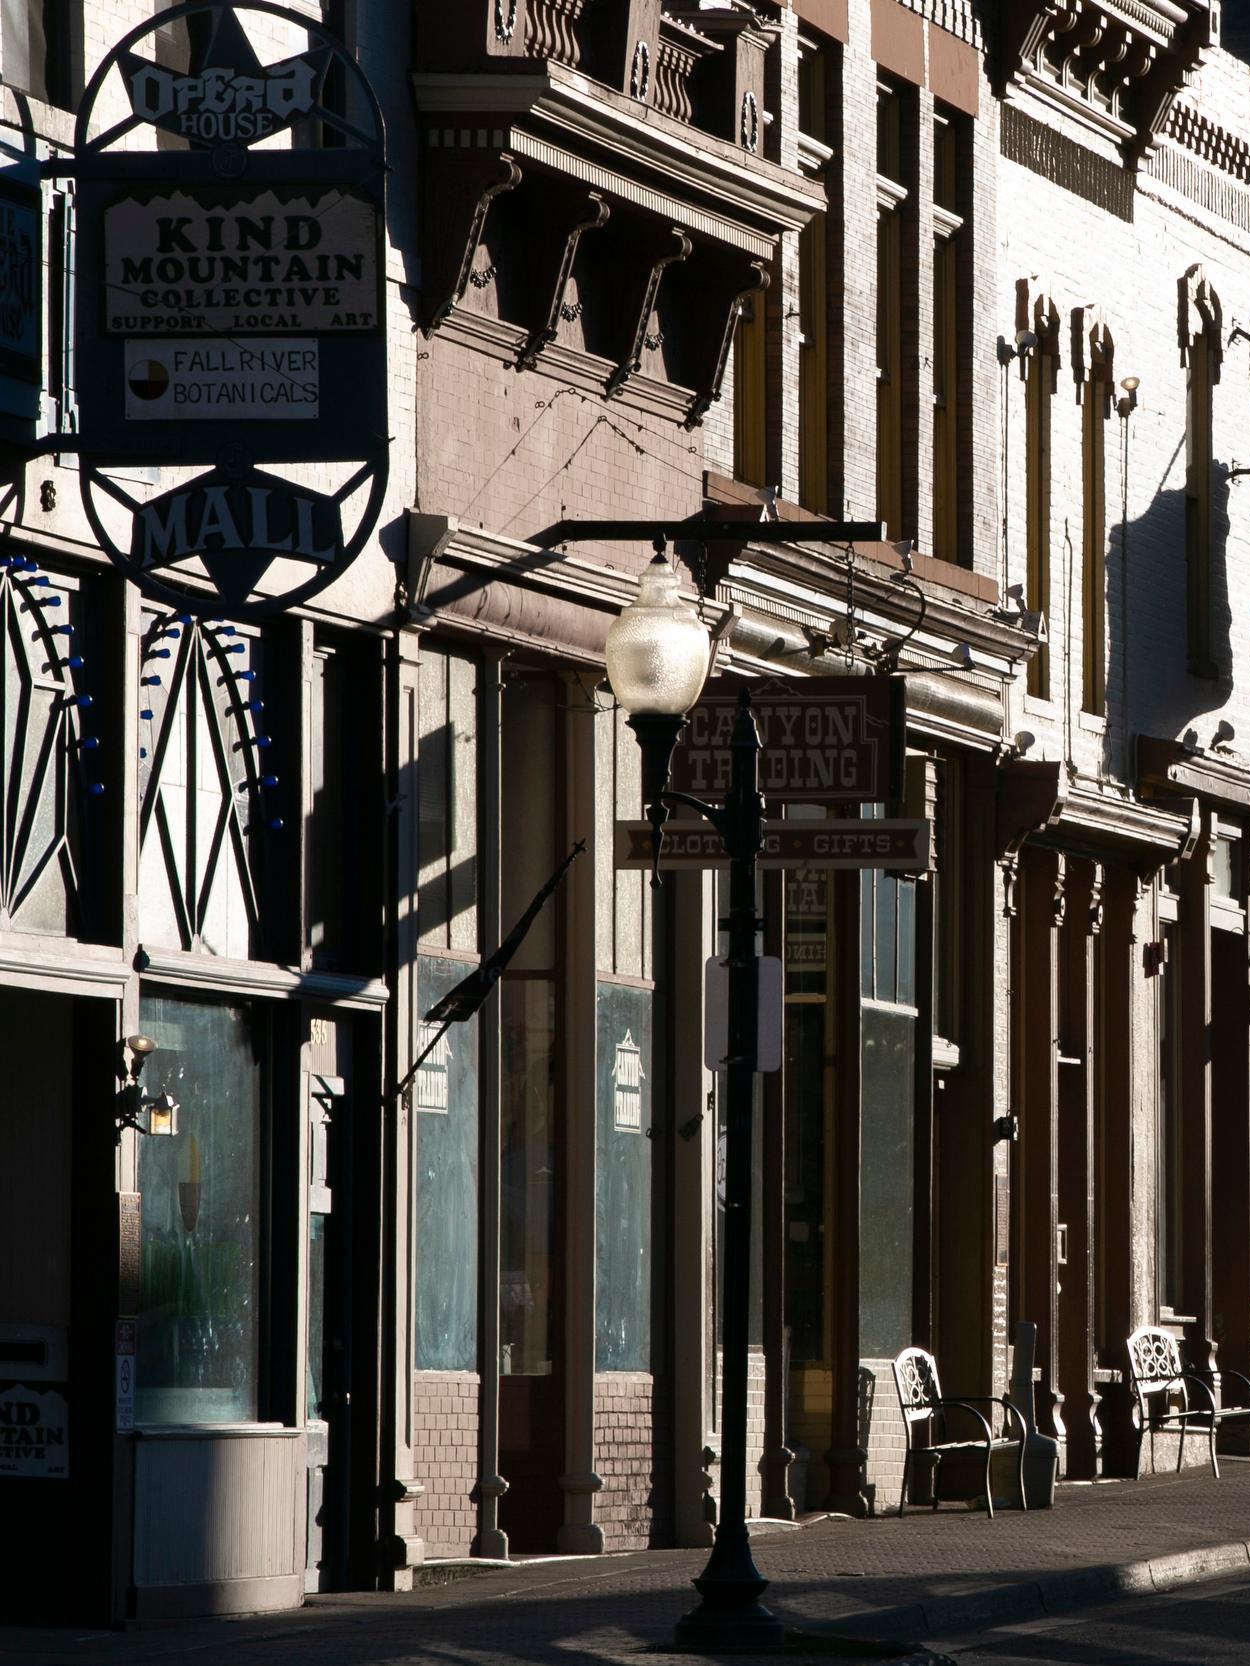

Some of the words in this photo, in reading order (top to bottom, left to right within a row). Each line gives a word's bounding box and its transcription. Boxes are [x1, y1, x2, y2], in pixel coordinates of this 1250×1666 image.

[131, 58, 318, 122] OPERA
[181, 113, 273, 139] HOUSE
[156, 215, 323, 253] KIND
[121, 254, 364, 285] MOUNTAIN
[140, 288, 341, 309] COLLECTIVE
[112, 315, 206, 330] SUPPORT
[233, 314, 303, 329] LOCAL
[330, 312, 374, 328] ART
[174, 383, 319, 404] BOTANICALS
[138, 484, 336, 568] MALL
[688, 749, 858, 789] TRDING
[813, 834, 892, 852] GIFTS
